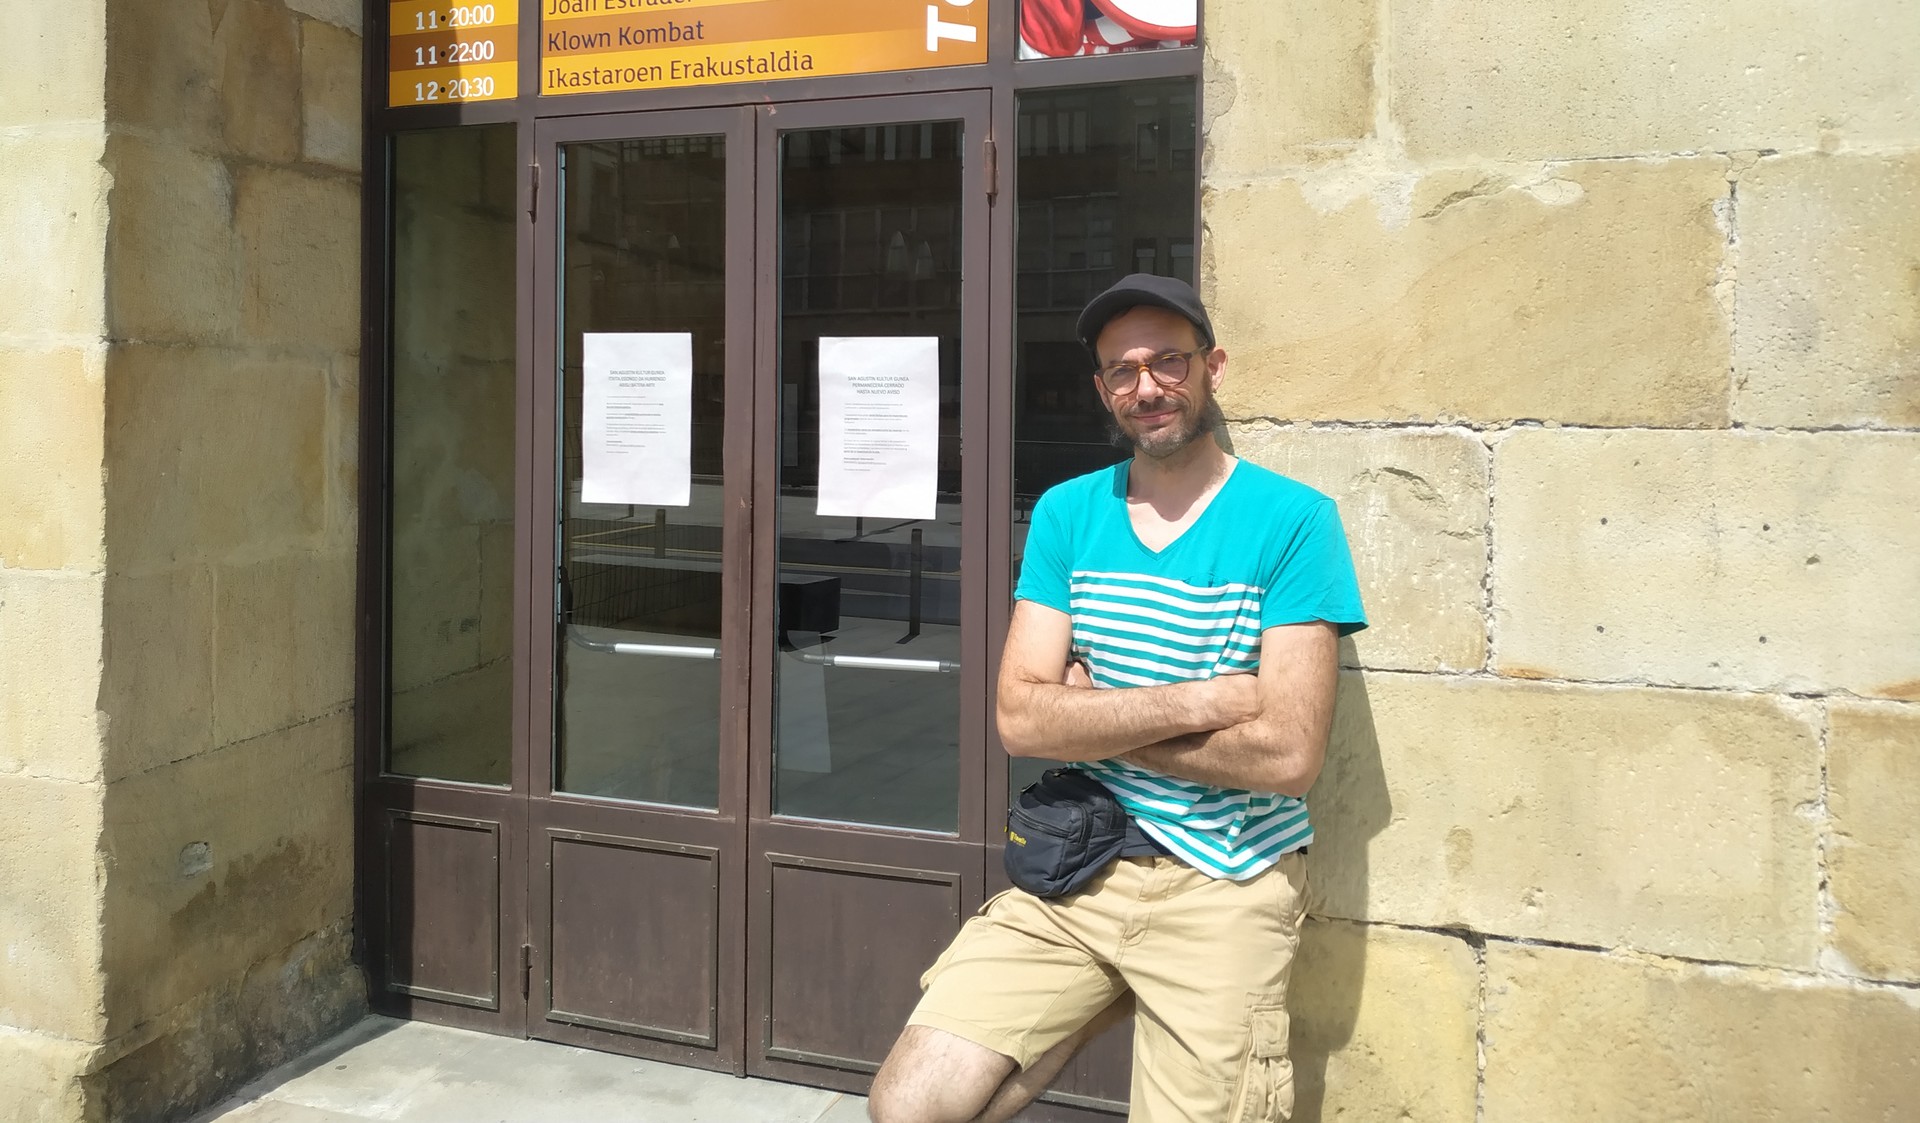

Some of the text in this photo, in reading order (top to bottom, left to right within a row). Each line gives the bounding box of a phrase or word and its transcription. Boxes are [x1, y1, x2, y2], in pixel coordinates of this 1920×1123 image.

[548, 0, 597, 15] Joan
[548, 20, 704, 52] Klown Kombat
[548, 50, 814, 88] Ikastaroen Erakustaldia
